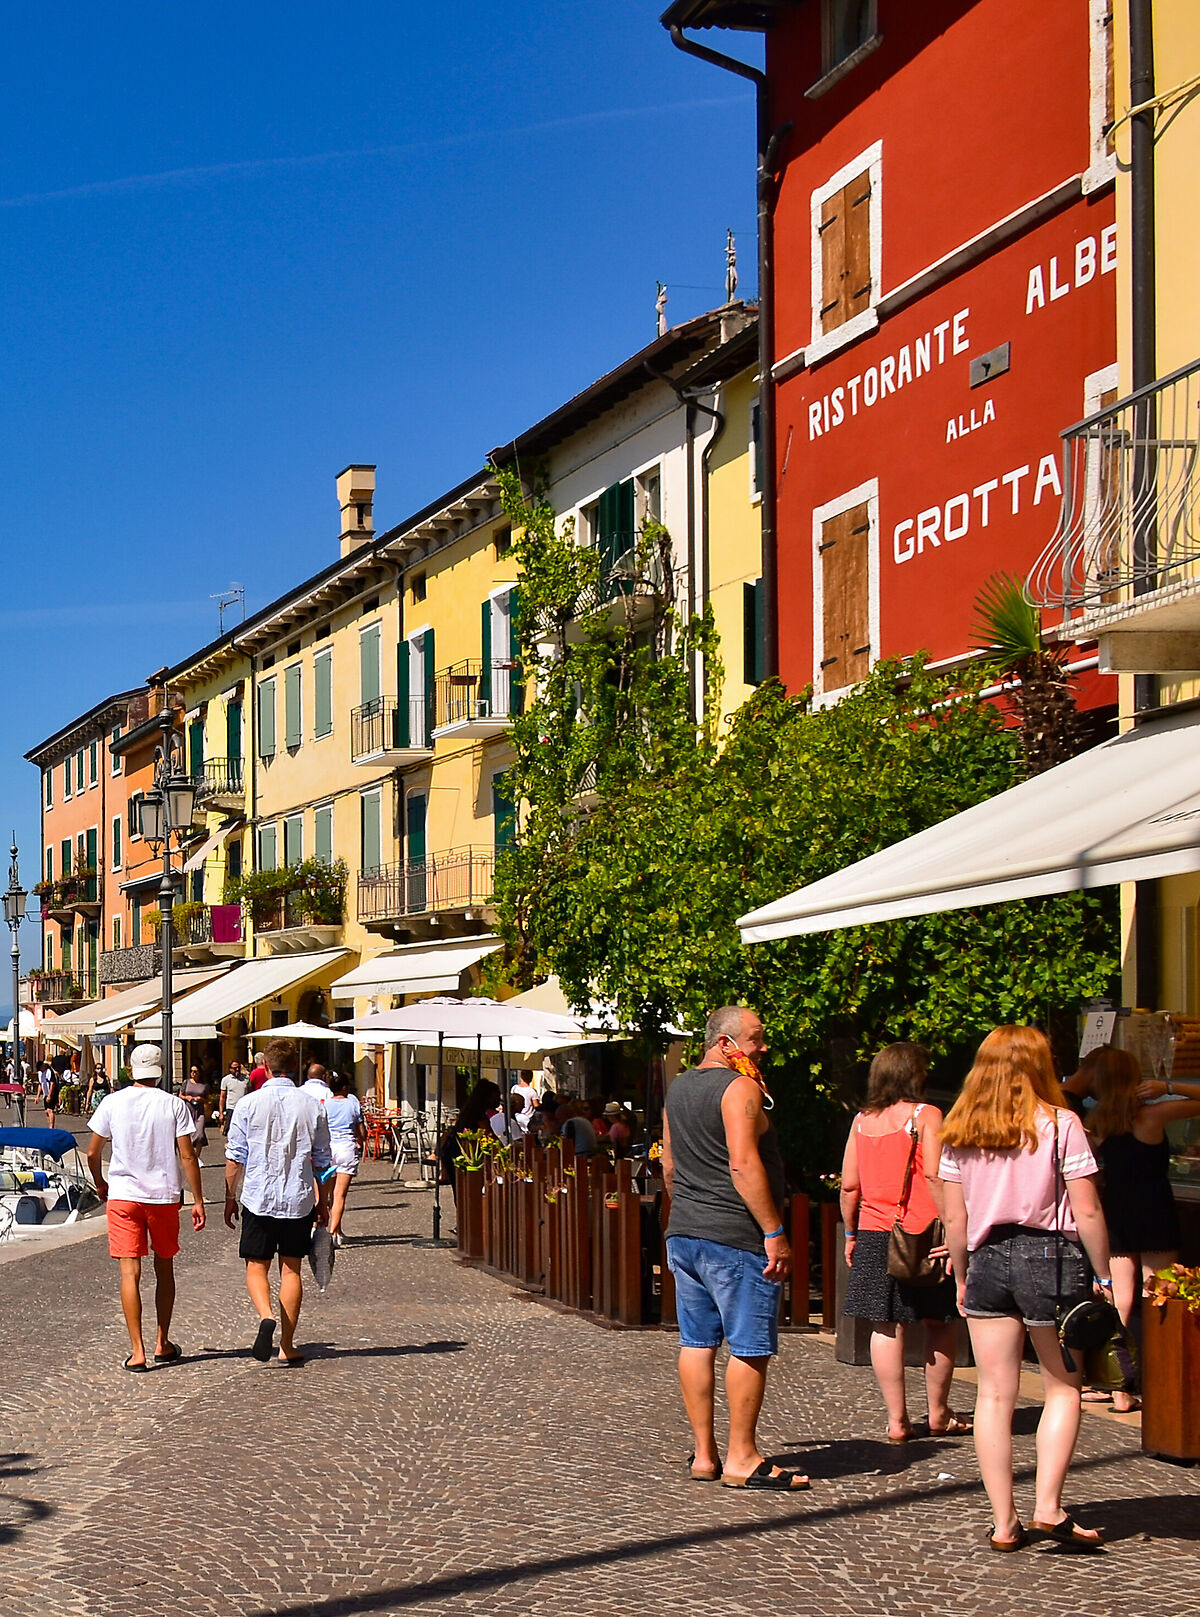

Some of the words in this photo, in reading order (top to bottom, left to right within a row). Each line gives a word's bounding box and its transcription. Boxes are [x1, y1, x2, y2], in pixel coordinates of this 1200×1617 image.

[808, 307, 970, 441] RISTORANTE
[1025, 222, 1117, 315] ALBE
[946, 399, 996, 444] ALLA
[893, 453, 1063, 565] GROTTA
